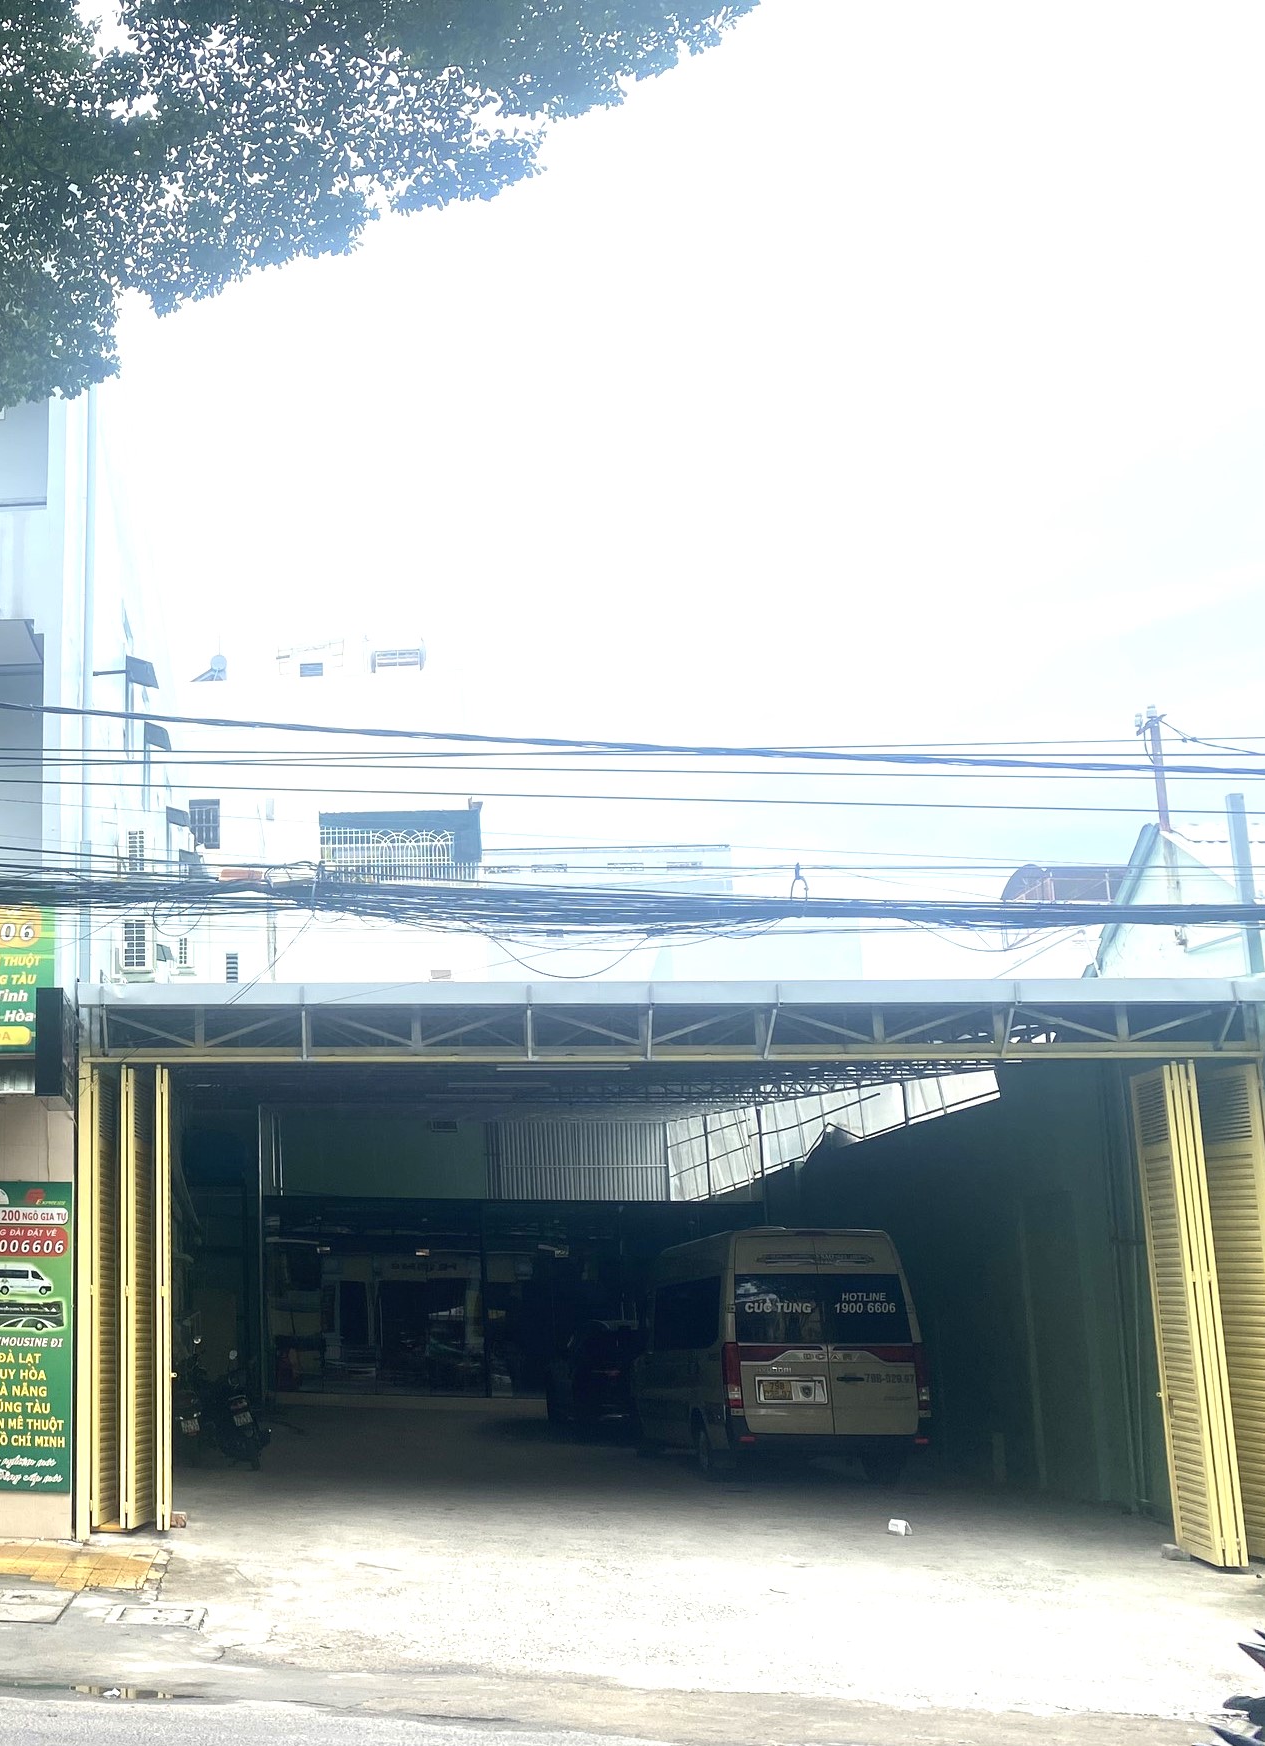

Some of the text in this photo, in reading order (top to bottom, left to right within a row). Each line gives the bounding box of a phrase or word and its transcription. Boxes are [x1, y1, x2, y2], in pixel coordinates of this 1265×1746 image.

[3, 953, 41, 968] THUỘT
[10, 972, 36, 985] TÀU
[4, 1009, 34, 1022] Hòa
[22, 1210, 38, 1221] NGÔ
[40, 1213, 54, 1221] GIA
[9, 1227, 24, 1236] ĐÀI
[841, 1292, 886, 1302] HOTLINE
[835, 1302, 896, 1314] 1900 6606
[50, 1338, 63, 1348] ĐI
[18, 1353, 41, 1367] LẠT
[19, 1365, 47, 1381] HÒA
[25, 1399, 51, 1414] TÀU
[7, 1415, 24, 1430] MÊ
[26, 1416, 65, 1434] THUỘT
[11, 1432, 32, 1447] CHÍ
[34, 1436, 65, 1448] MINH
